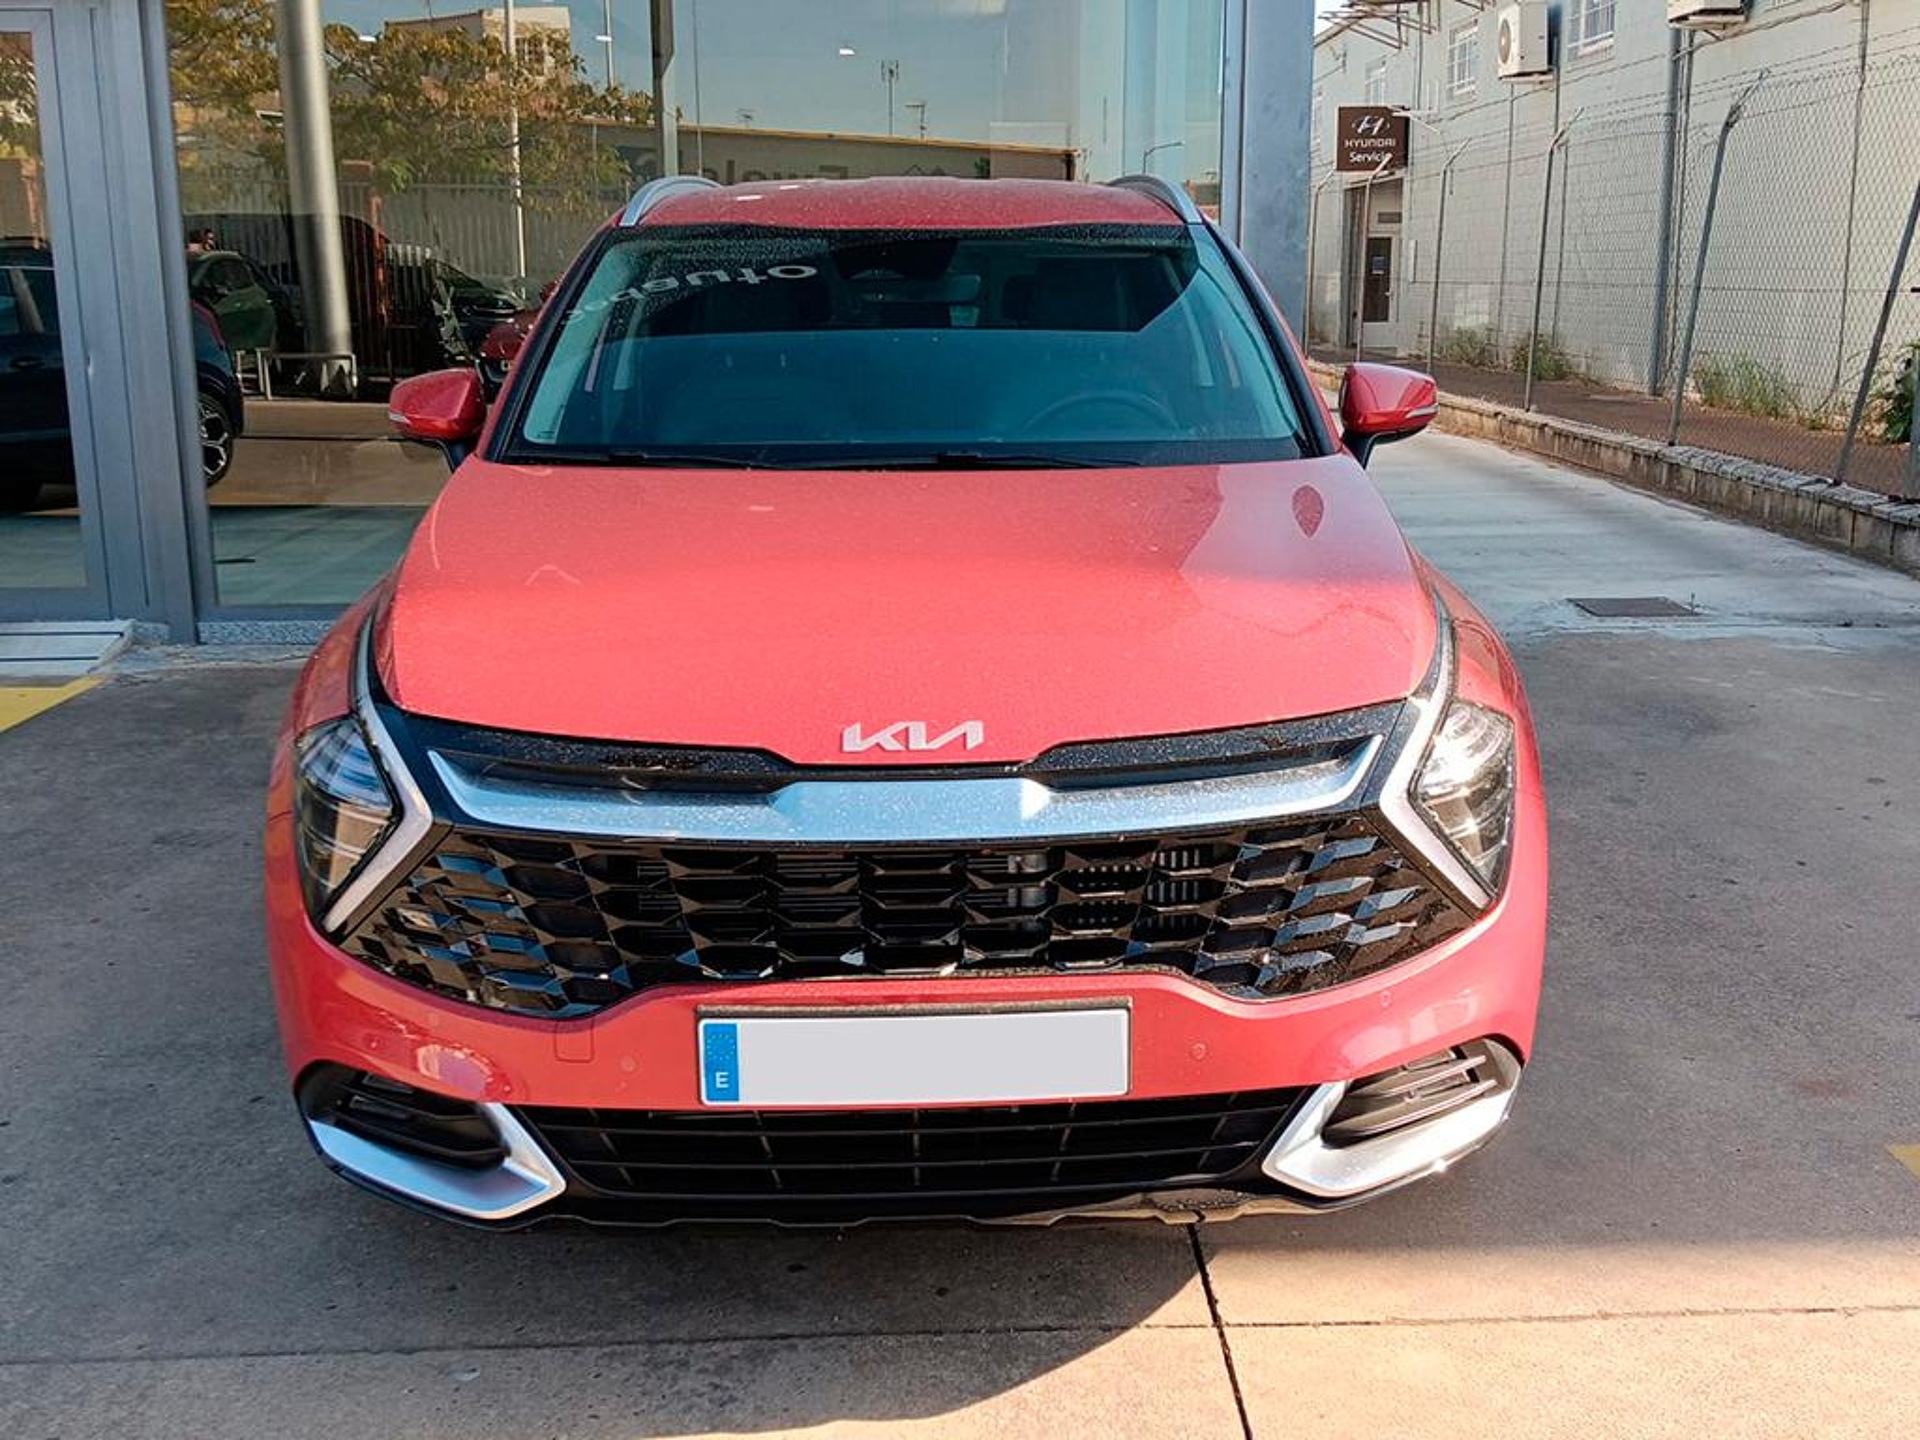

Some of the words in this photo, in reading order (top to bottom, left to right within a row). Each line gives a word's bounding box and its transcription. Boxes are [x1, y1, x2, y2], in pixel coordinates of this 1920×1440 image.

[1344, 138, 1396, 148] HYUNDAI
[1349, 151, 1390, 163] Servici
[842, 720, 984, 752] KIA
[715, 1071, 729, 1089] E
